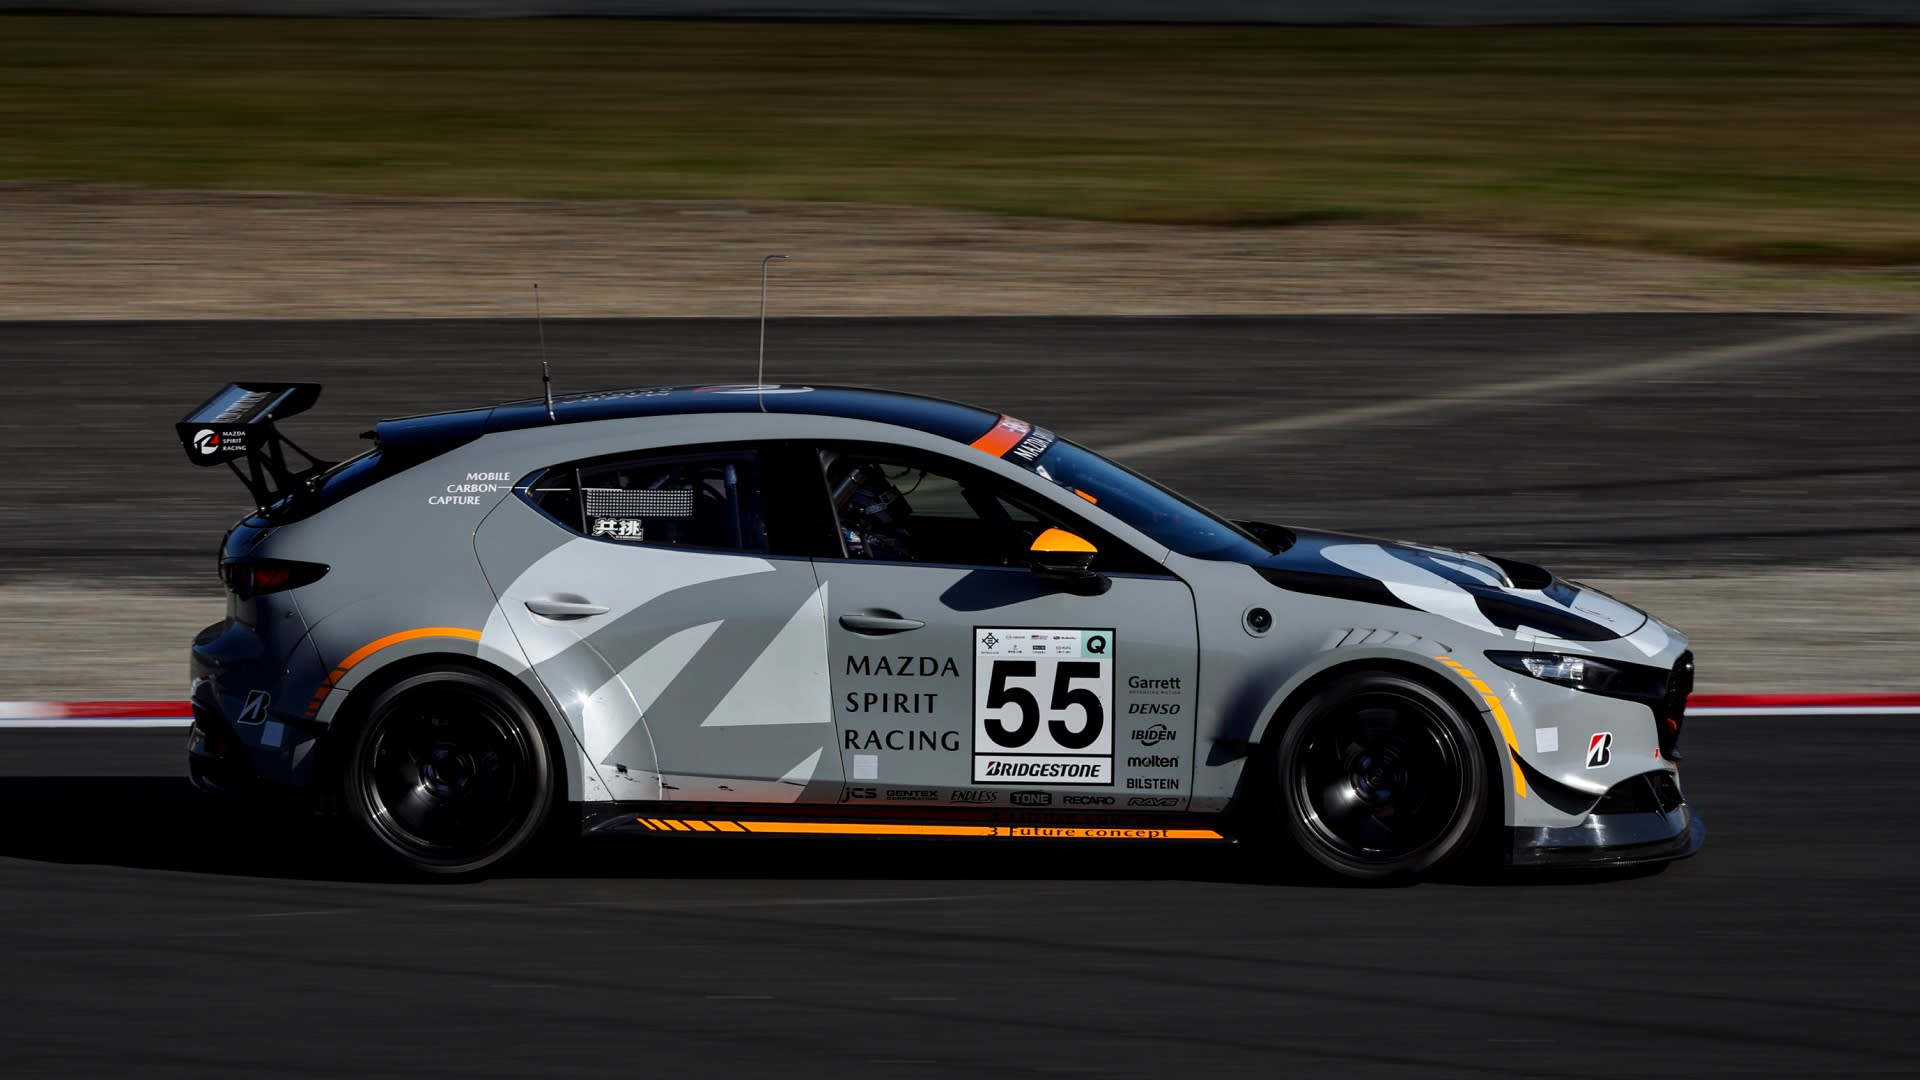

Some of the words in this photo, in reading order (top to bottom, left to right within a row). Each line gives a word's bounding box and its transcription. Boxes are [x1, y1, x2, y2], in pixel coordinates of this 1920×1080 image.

[466, 471, 511, 481] MOBILE
[447, 484, 497, 493] CARBON
[428, 496, 481, 505] CAPTURE
[1087, 635, 1106, 654] Q
[846, 655, 960, 677] MAZDA
[1128, 676, 1181, 690] Garrett
[845, 692, 938, 714] SPIRIT
[984, 660, 1104, 749] 55
[1128, 703, 1181, 715] DENSO
[844, 729, 960, 752] RACING
[1131, 728, 1177, 742] IBIDEN
[1127, 755, 1179, 768] molten
[986, 761, 1101, 777] BRIDGESTONE
[1126, 778, 1179, 789] BILSTEIN
[951, 790, 998, 803] ENDLESS
[1012, 793, 1050, 805] TONE
[1063, 796, 1116, 805] RECARO
[1009, 826, 1076, 837] Future
[1085, 828, 1168, 839] concept
